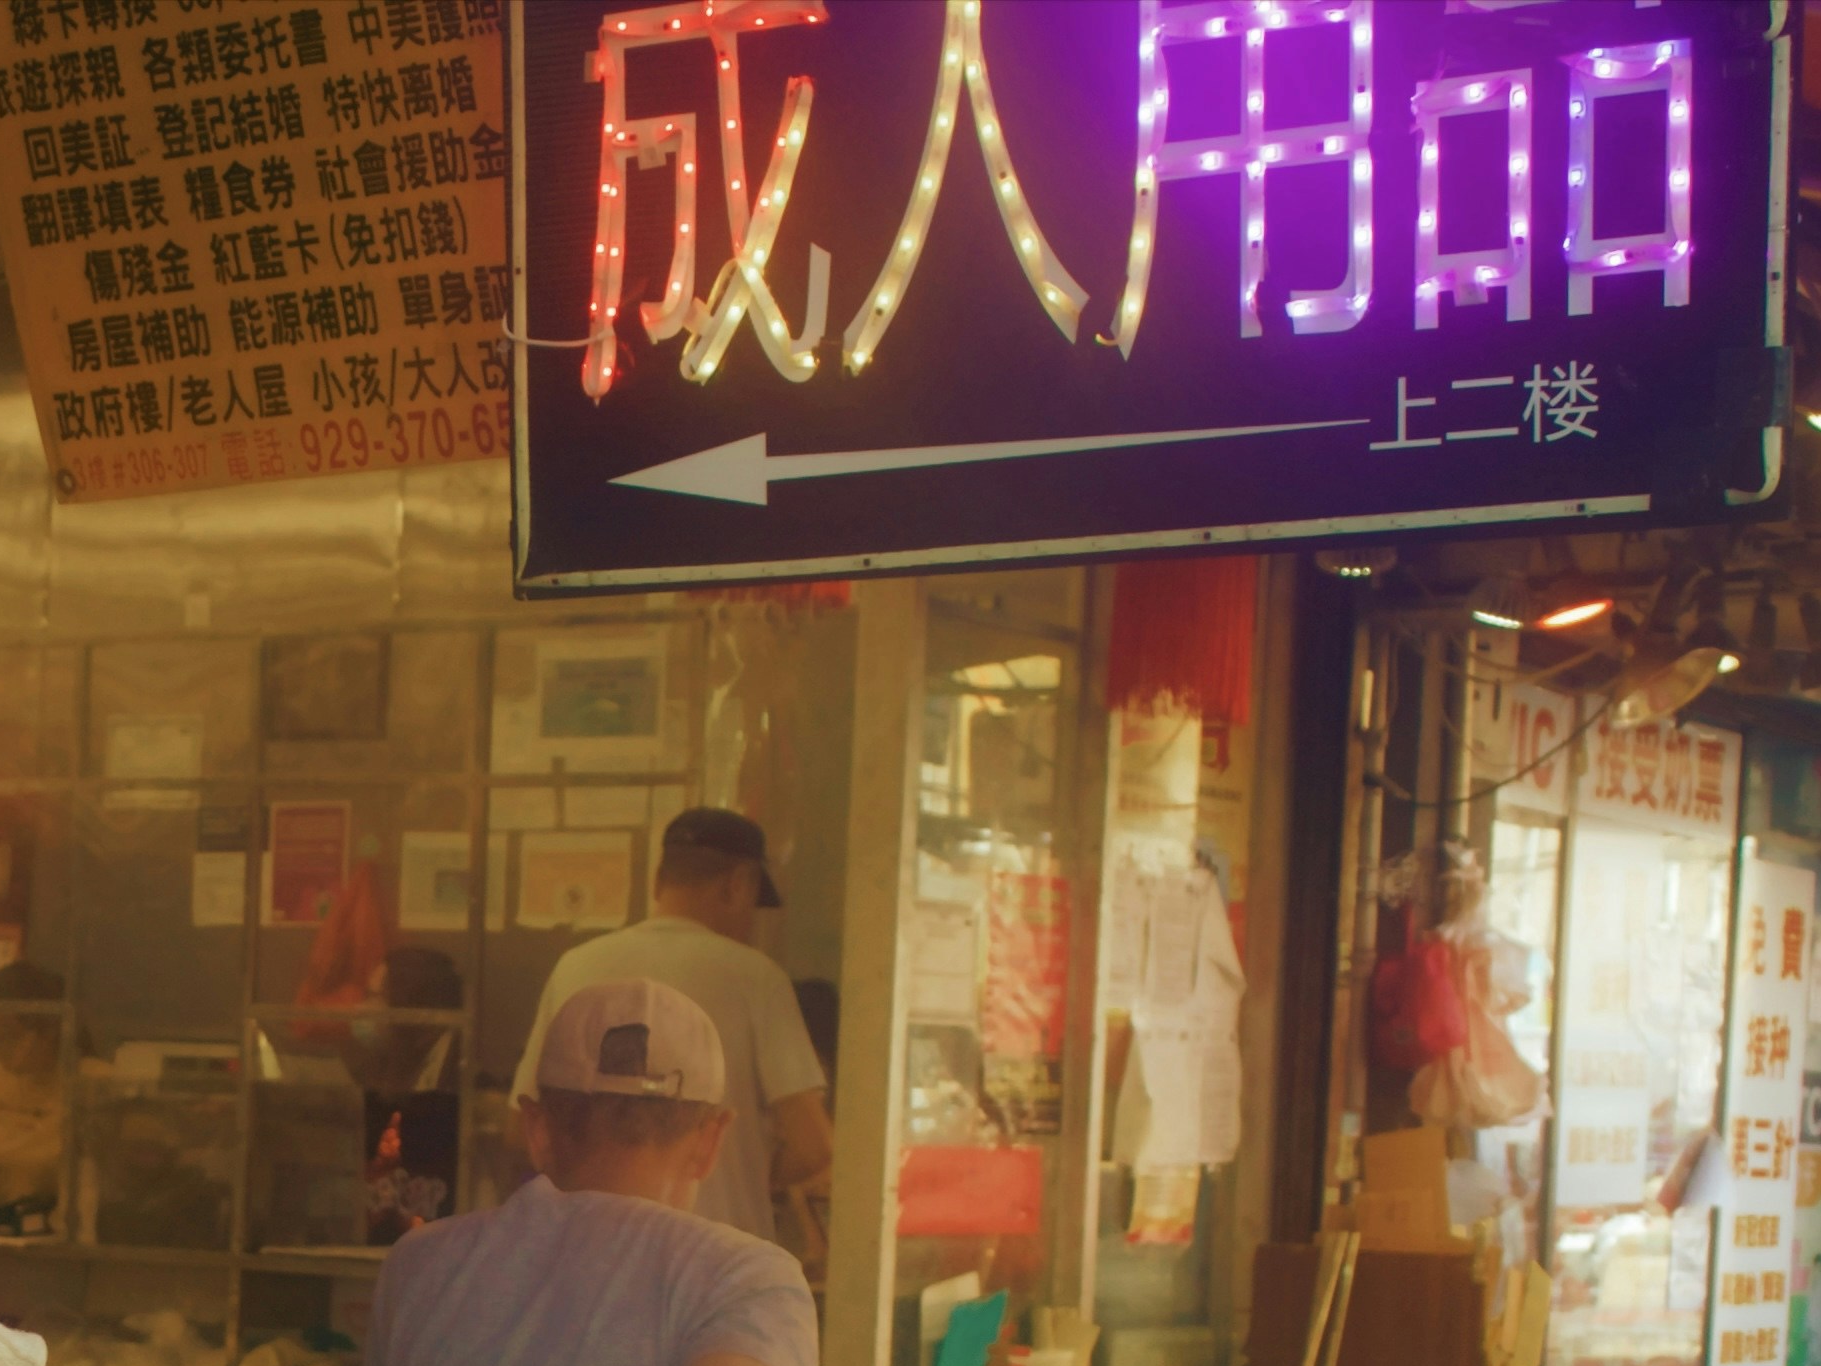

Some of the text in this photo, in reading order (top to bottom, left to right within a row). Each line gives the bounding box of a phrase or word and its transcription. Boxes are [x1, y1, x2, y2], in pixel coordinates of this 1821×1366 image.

[154, 82, 305, 161] 登記結婚
[580, 0, 1693, 406] 成人用品
[66, 304, 212, 375] 房屋補助
[228, 282, 381, 354] 能源補助
[1368, 361, 1602, 453] 上二楼
